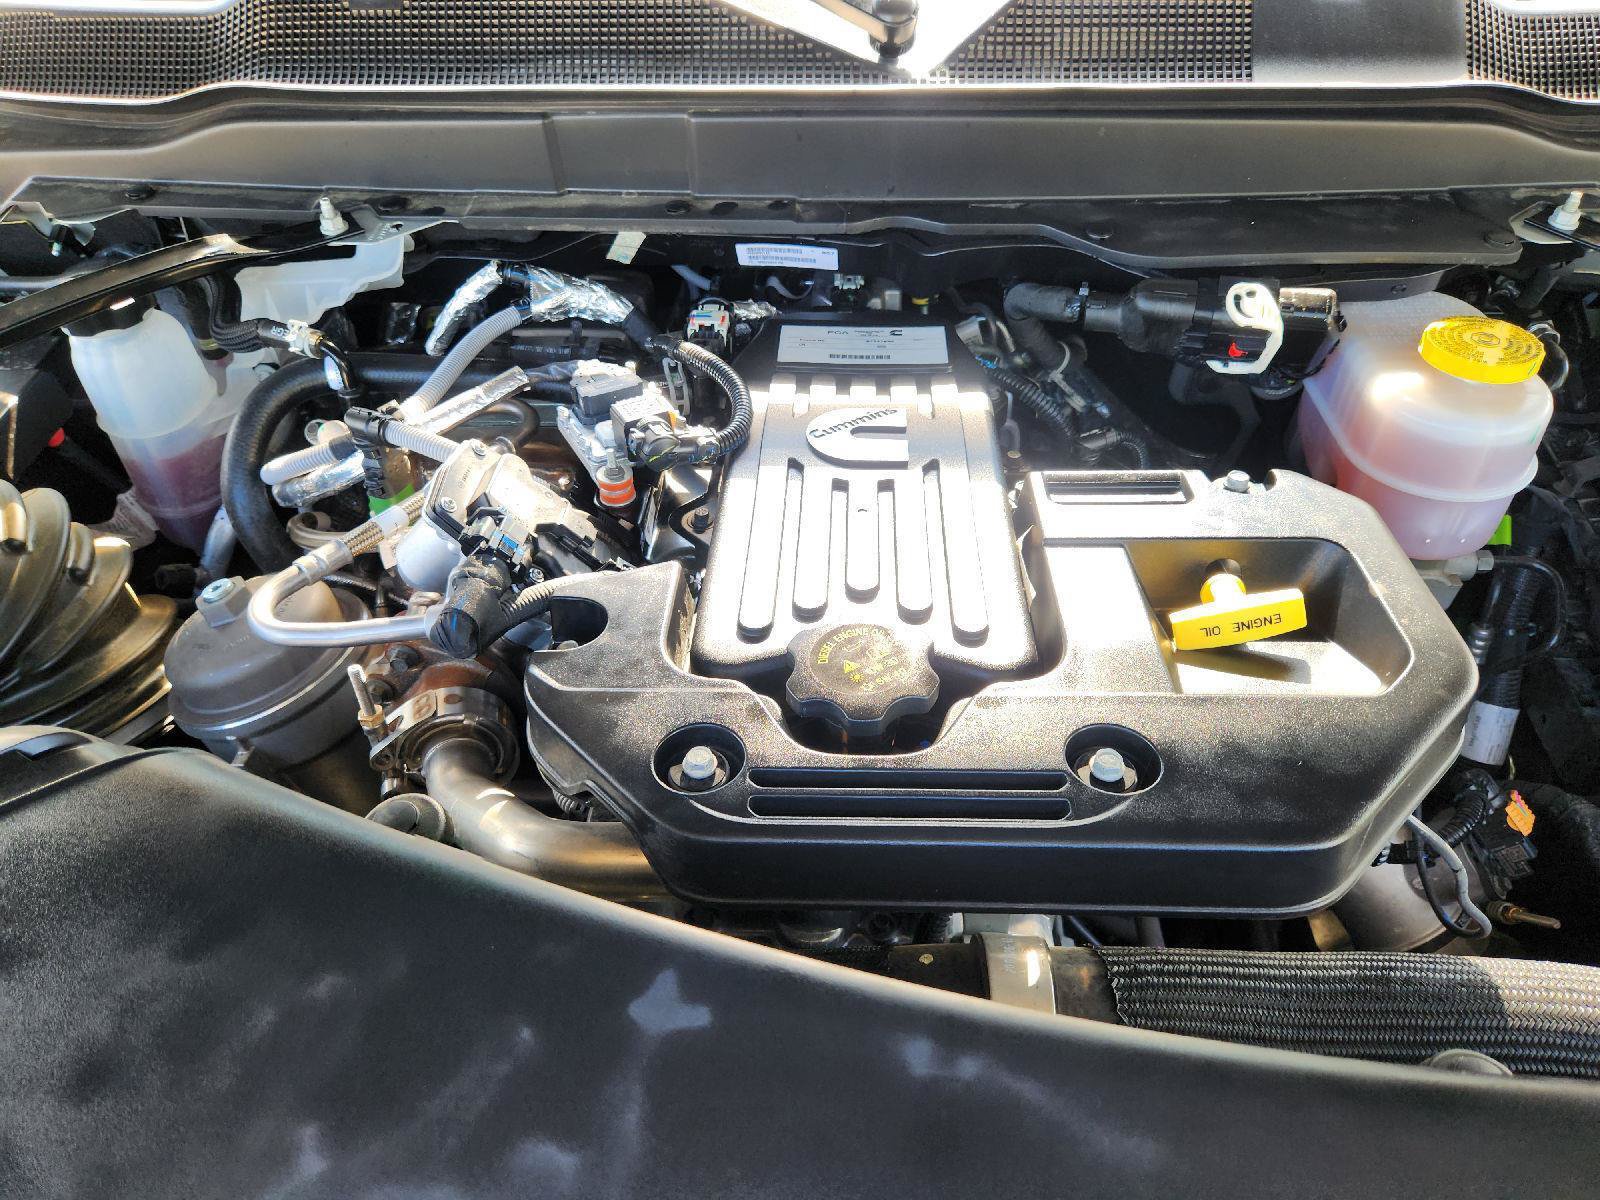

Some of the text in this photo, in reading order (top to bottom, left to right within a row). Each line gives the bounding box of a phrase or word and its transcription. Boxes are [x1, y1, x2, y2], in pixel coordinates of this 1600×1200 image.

[808, 408, 898, 438] Cummins
[832, 628, 868, 642] ENGINE
[1200, 613, 1281, 636] ENGINE OIL
